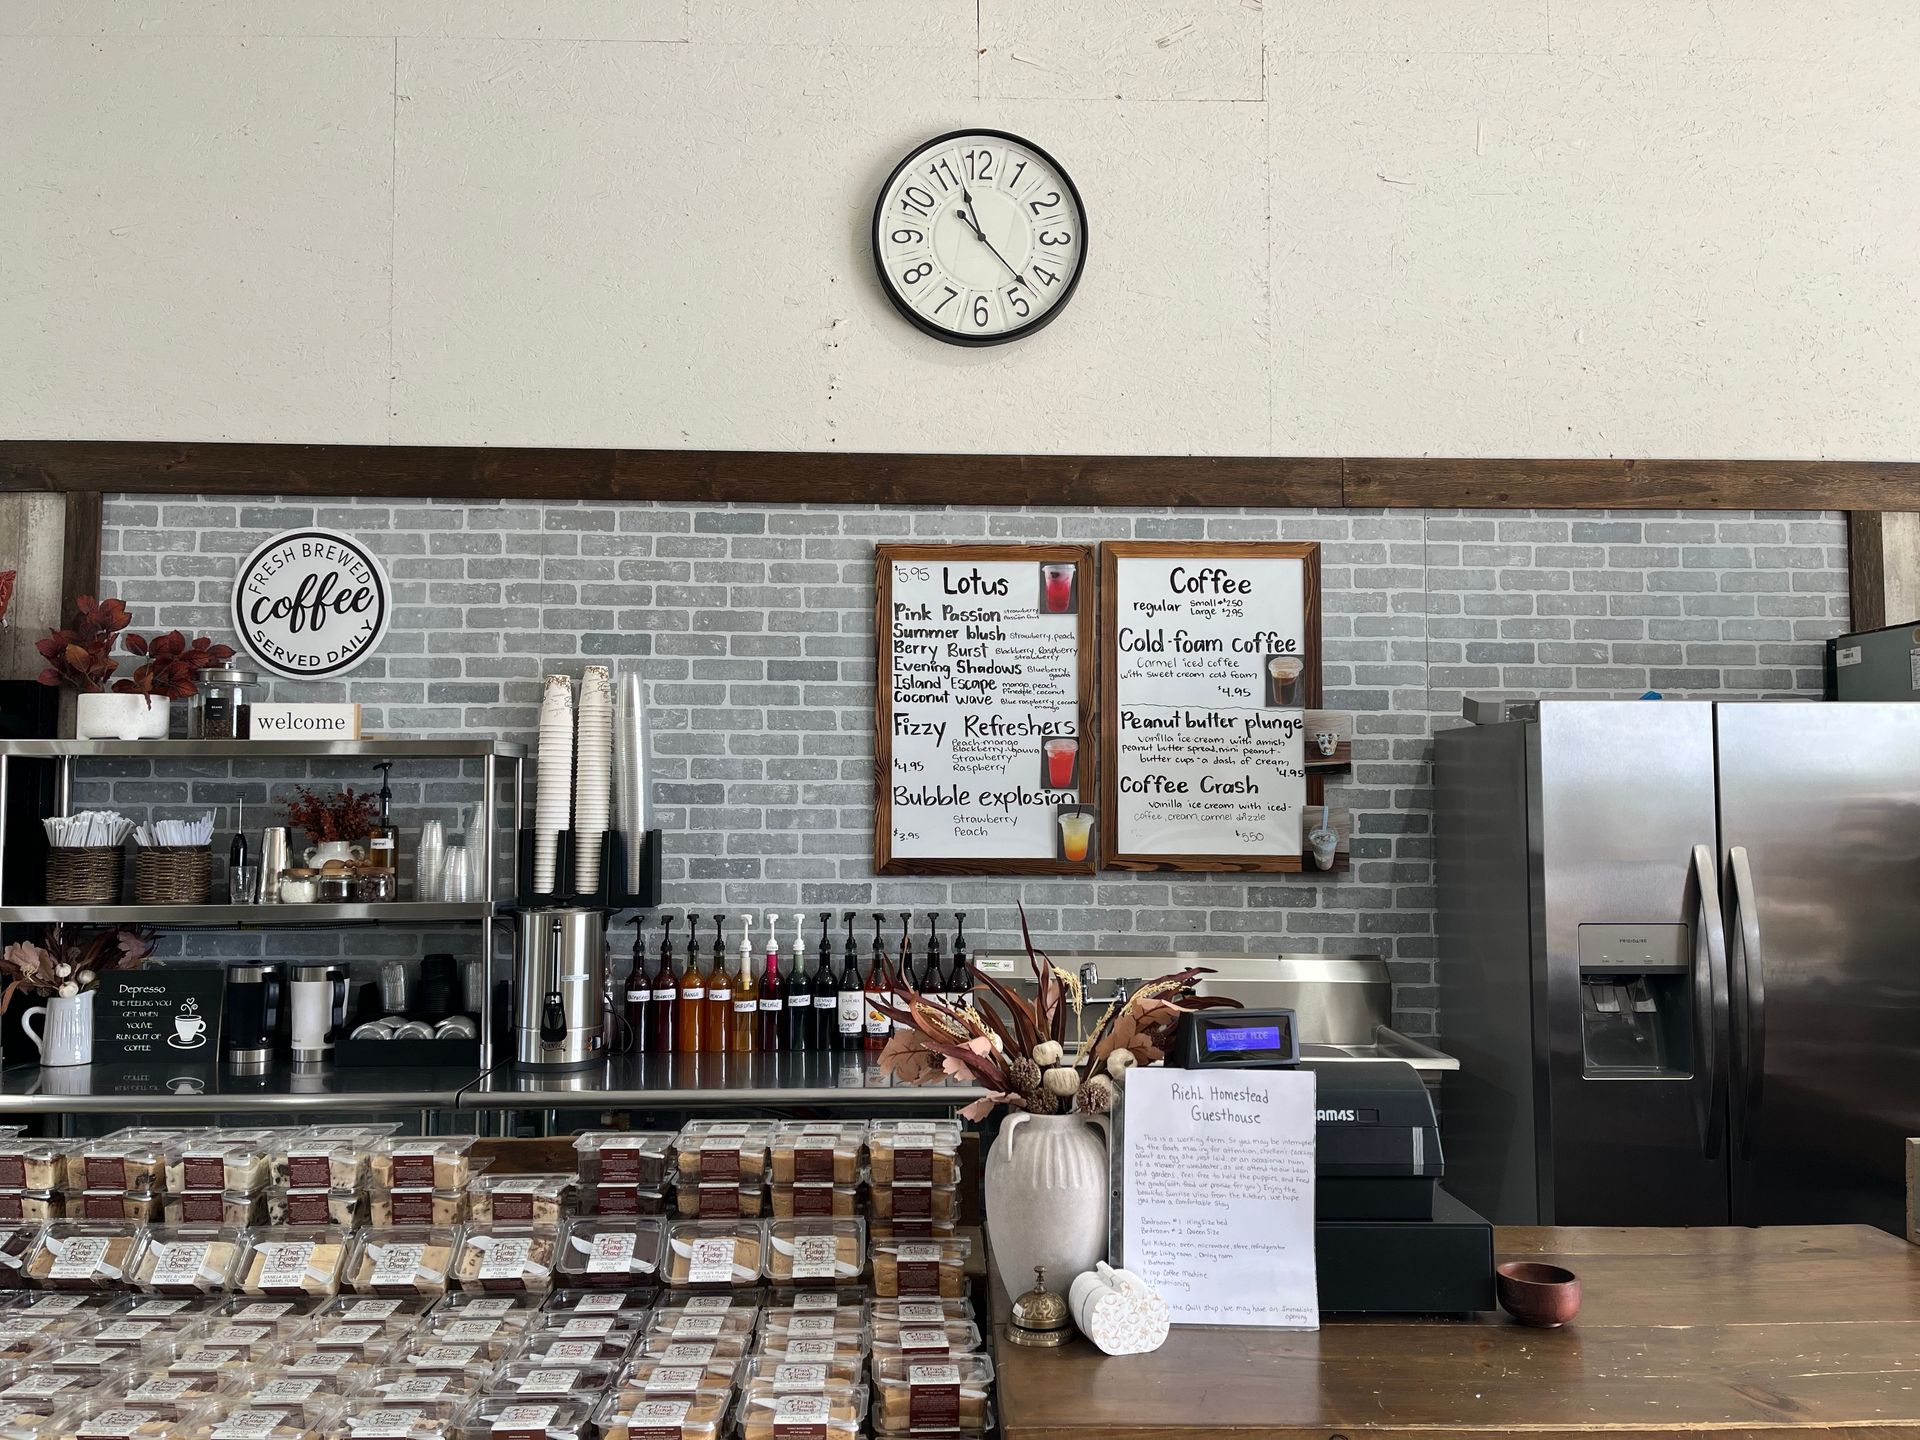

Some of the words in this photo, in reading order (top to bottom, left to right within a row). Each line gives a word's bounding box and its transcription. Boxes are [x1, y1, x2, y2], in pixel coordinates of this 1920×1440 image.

[929, 158, 959, 192] 11
[965, 149, 993, 181] 12
[1009, 161, 1028, 188] 1
[901, 186, 935, 217] 10
[1029, 191, 1061, 216] 2
[891, 229, 924, 244] 9
[1039, 230, 1072, 246] 3
[903, 262, 933, 285] 8
[1032, 265, 1061, 287] 4
[934, 285, 959, 314] 7
[1006, 286, 1030, 318] 5
[973, 295, 989, 327] 6
[249, 547, 296, 595] FRESH
[302, 543, 371, 584] BREWED
[943, 567, 1009, 596] Lotus
[1170, 567, 1252, 594] Coffee
[250, 571, 374, 634] coffee
[894, 602, 932, 622] Pink
[942, 604, 1001, 622] Passion
[1133, 599, 1182, 618] regular
[893, 623, 960, 639] Summer
[966, 625, 1006, 641] blush
[1232, 631, 1296, 653] coffee
[253, 630, 320, 666] SERVED
[327, 619, 373, 663] DAILY
[894, 640, 938, 661] Berry
[947, 643, 988, 658] Burst
[894, 656, 950, 679] Evening
[957, 660, 1022, 675] Shadows
[1137, 657, 1177, 669] Carmel
[1182, 657, 1204, 668] iced
[1207, 657, 1240, 668] coffee
[894, 674, 941, 690] Island
[951, 676, 997, 694] Escape
[1120, 669, 1143, 680] with
[1147, 671, 1173, 679] sweet
[1209, 671, 1227, 679] cold
[1230, 670, 1258, 679] foam
[894, 690, 950, 704] Coconut
[955, 693, 993, 705] wave
[258, 712, 345, 730] welcome
[893, 712, 947, 748] Fizzy
[964, 714, 1076, 737] Refreshers
[1120, 710, 1180, 730] Peanut
[1185, 711, 1239, 729] butter
[1245, 712, 1304, 739] plunge
[1122, 744, 1152, 754] peanut
[1157, 744, 1184, 752] butter
[1138, 733, 1174, 743] vanilla
[1230, 736, 1252, 745] with
[952, 753, 1012, 764] Strawberry
[1140, 753, 1172, 763] butter
[1175, 757, 1195, 765] cups
[1213, 757, 1235, 765] dash
[1241, 756, 1252, 765] of
[953, 764, 1006, 774] Raspberry
[1120, 775, 1189, 794] Coffee
[1200, 775, 1259, 794] Crash
[893, 784, 971, 806] Bubble
[978, 786, 1076, 813] explosion
[1149, 800, 1182, 809] vanilla
[1187, 800, 1202, 809] ice
[1239, 801, 1261, 810] with
[953, 815, 1018, 826] Strawberry
[954, 827, 988, 837] Peach
[119, 984, 166, 999] Depresso
[1211, 1032, 1246, 1041] REGISTER
[1210, 1086, 1269, 1104] Homestead
[1191, 1104, 1262, 1124] Guesthouse
